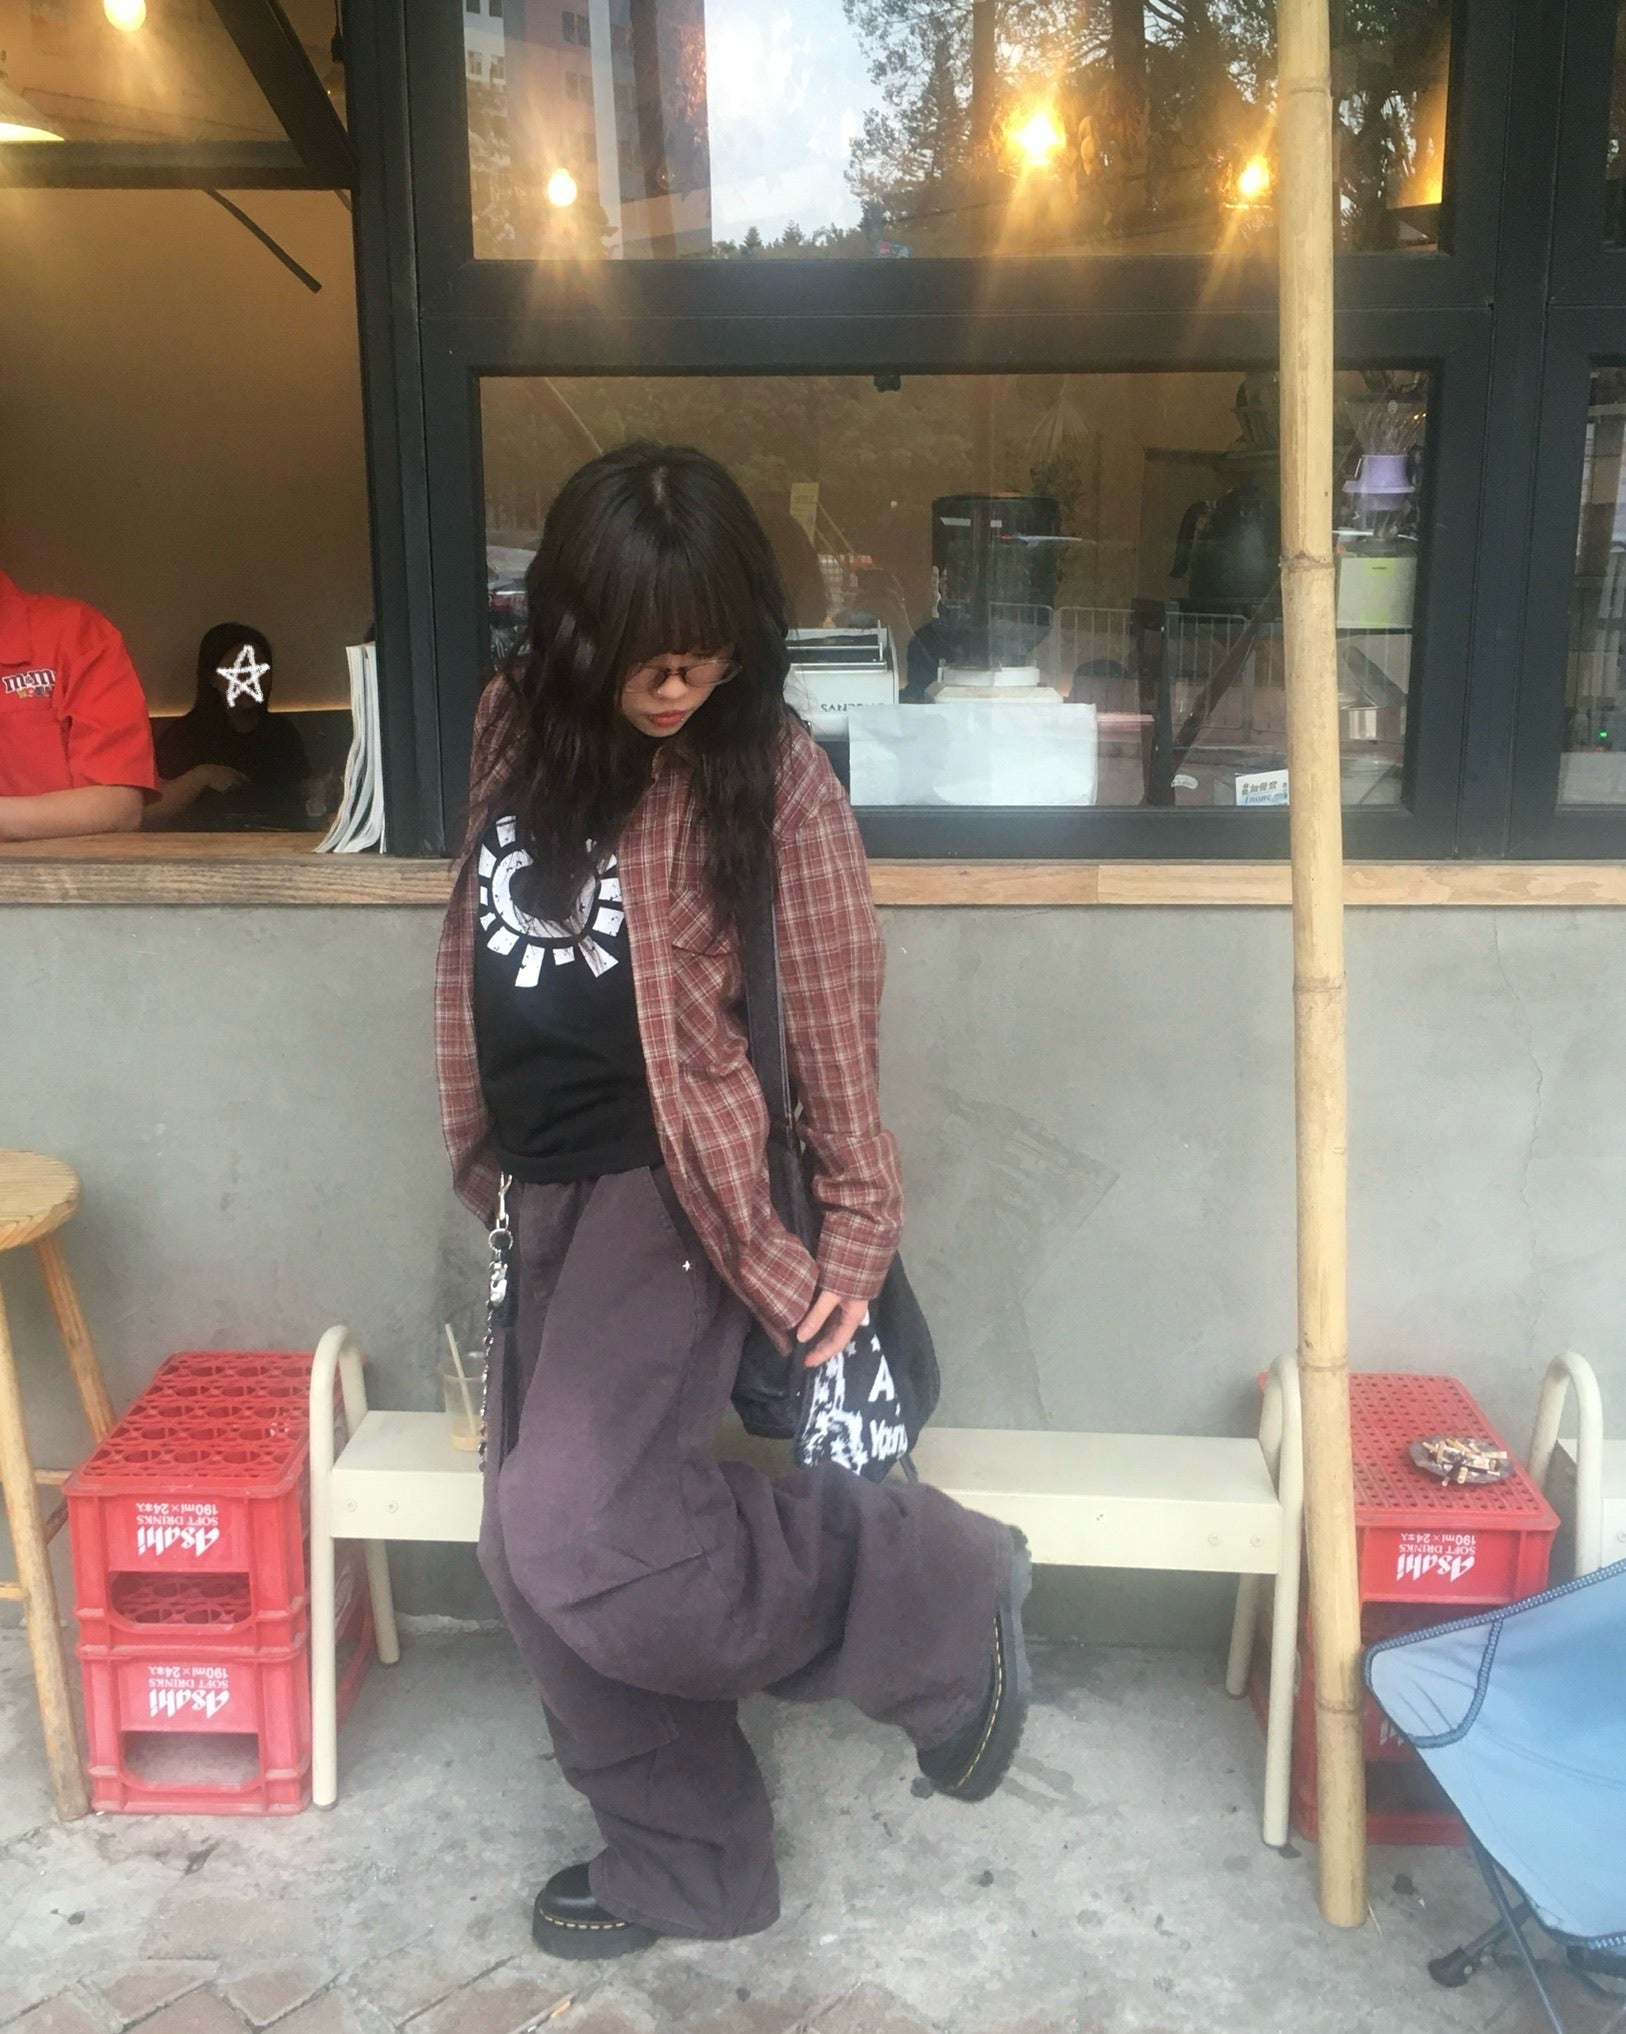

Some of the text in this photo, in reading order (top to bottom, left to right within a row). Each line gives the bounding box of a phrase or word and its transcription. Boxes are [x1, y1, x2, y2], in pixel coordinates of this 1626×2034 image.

[867, 1354, 895, 1402] A
[181, 1503, 219, 1516] 190ml
[136, 1515, 219, 1526] SOFT DRINKS
[137, 1526, 220, 1558] Asahi
[1441, 1534, 1477, 1546] 190ml
[1399, 1544, 1477, 1555] SOFT DRINKS
[1396, 1554, 1475, 1583] Asahi
[192, 1667, 229, 1679] 190ml
[148, 1678, 229, 1689] SOFT DRINKS
[149, 1688, 230, 1719] Asahi
